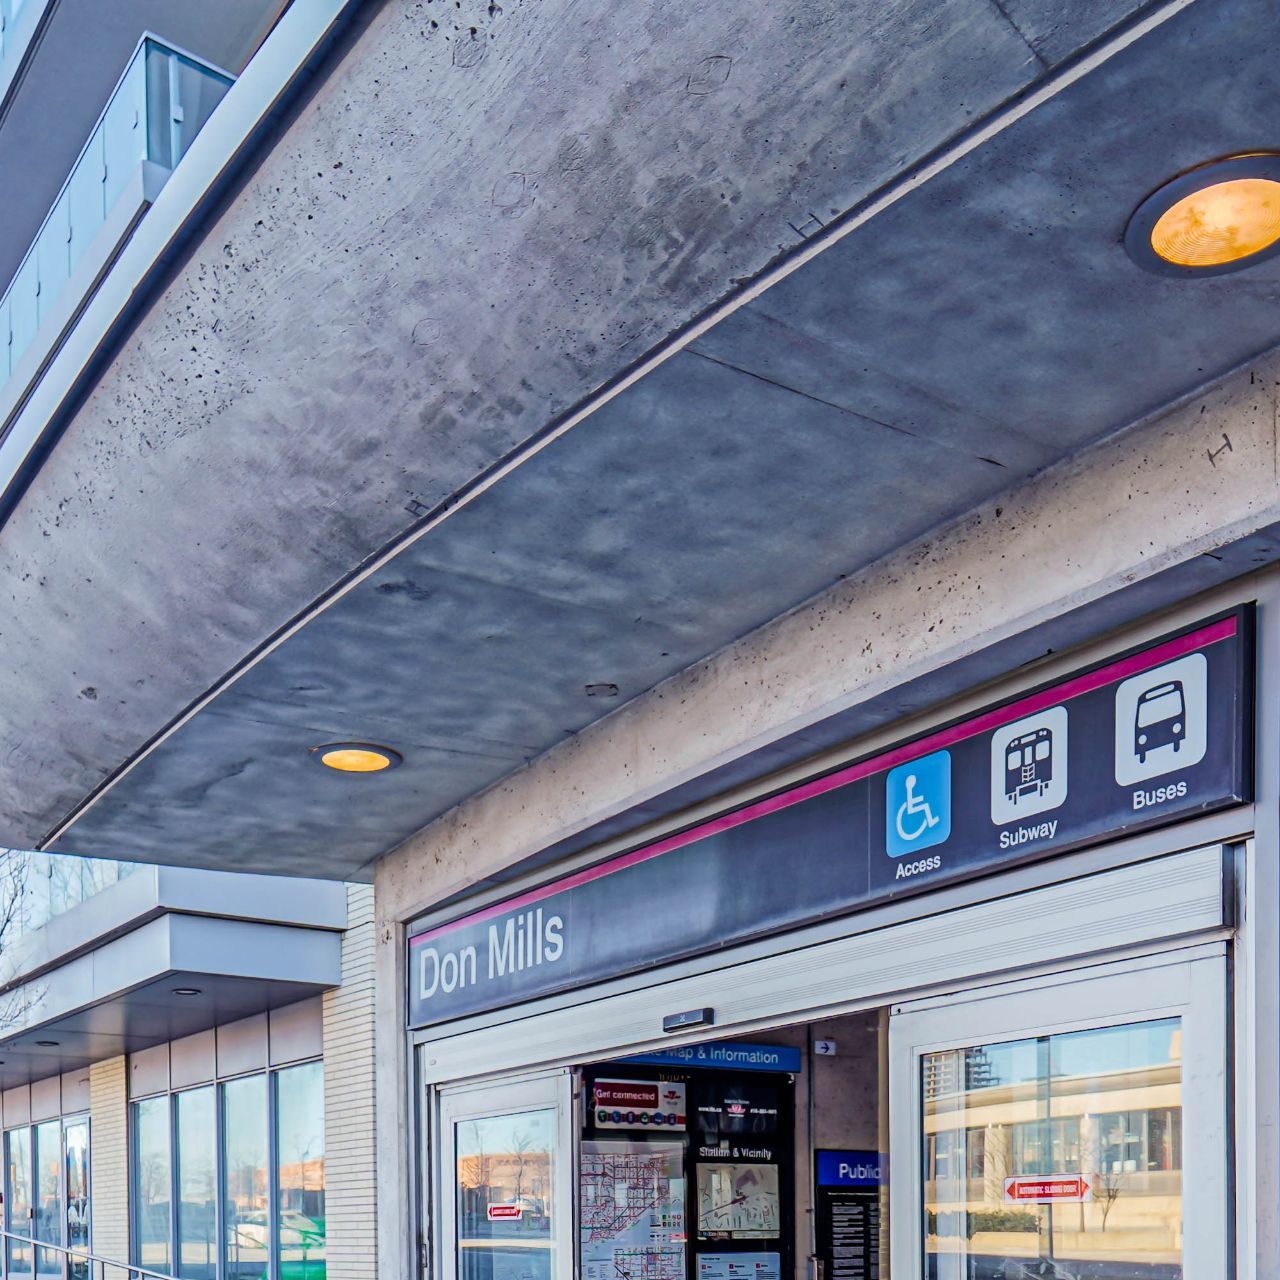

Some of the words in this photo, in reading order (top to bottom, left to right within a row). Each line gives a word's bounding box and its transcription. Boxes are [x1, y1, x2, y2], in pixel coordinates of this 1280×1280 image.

[1132, 779, 1187, 811] Buses
[999, 819, 1058, 850] Subway
[895, 853, 941, 880] Access
[419, 939, 476, 1001] Don
[487, 908, 565, 978] Mills
[698, 1047, 706, 1059] &
[710, 1047, 779, 1064] Information
[596, 1089, 611, 1099] Get
[612, 1090, 656, 1101] connected
[699, 1146, 730, 1158] Station
[732, 1148, 740, 1158] &
[741, 1148, 773, 1160] Vicinity
